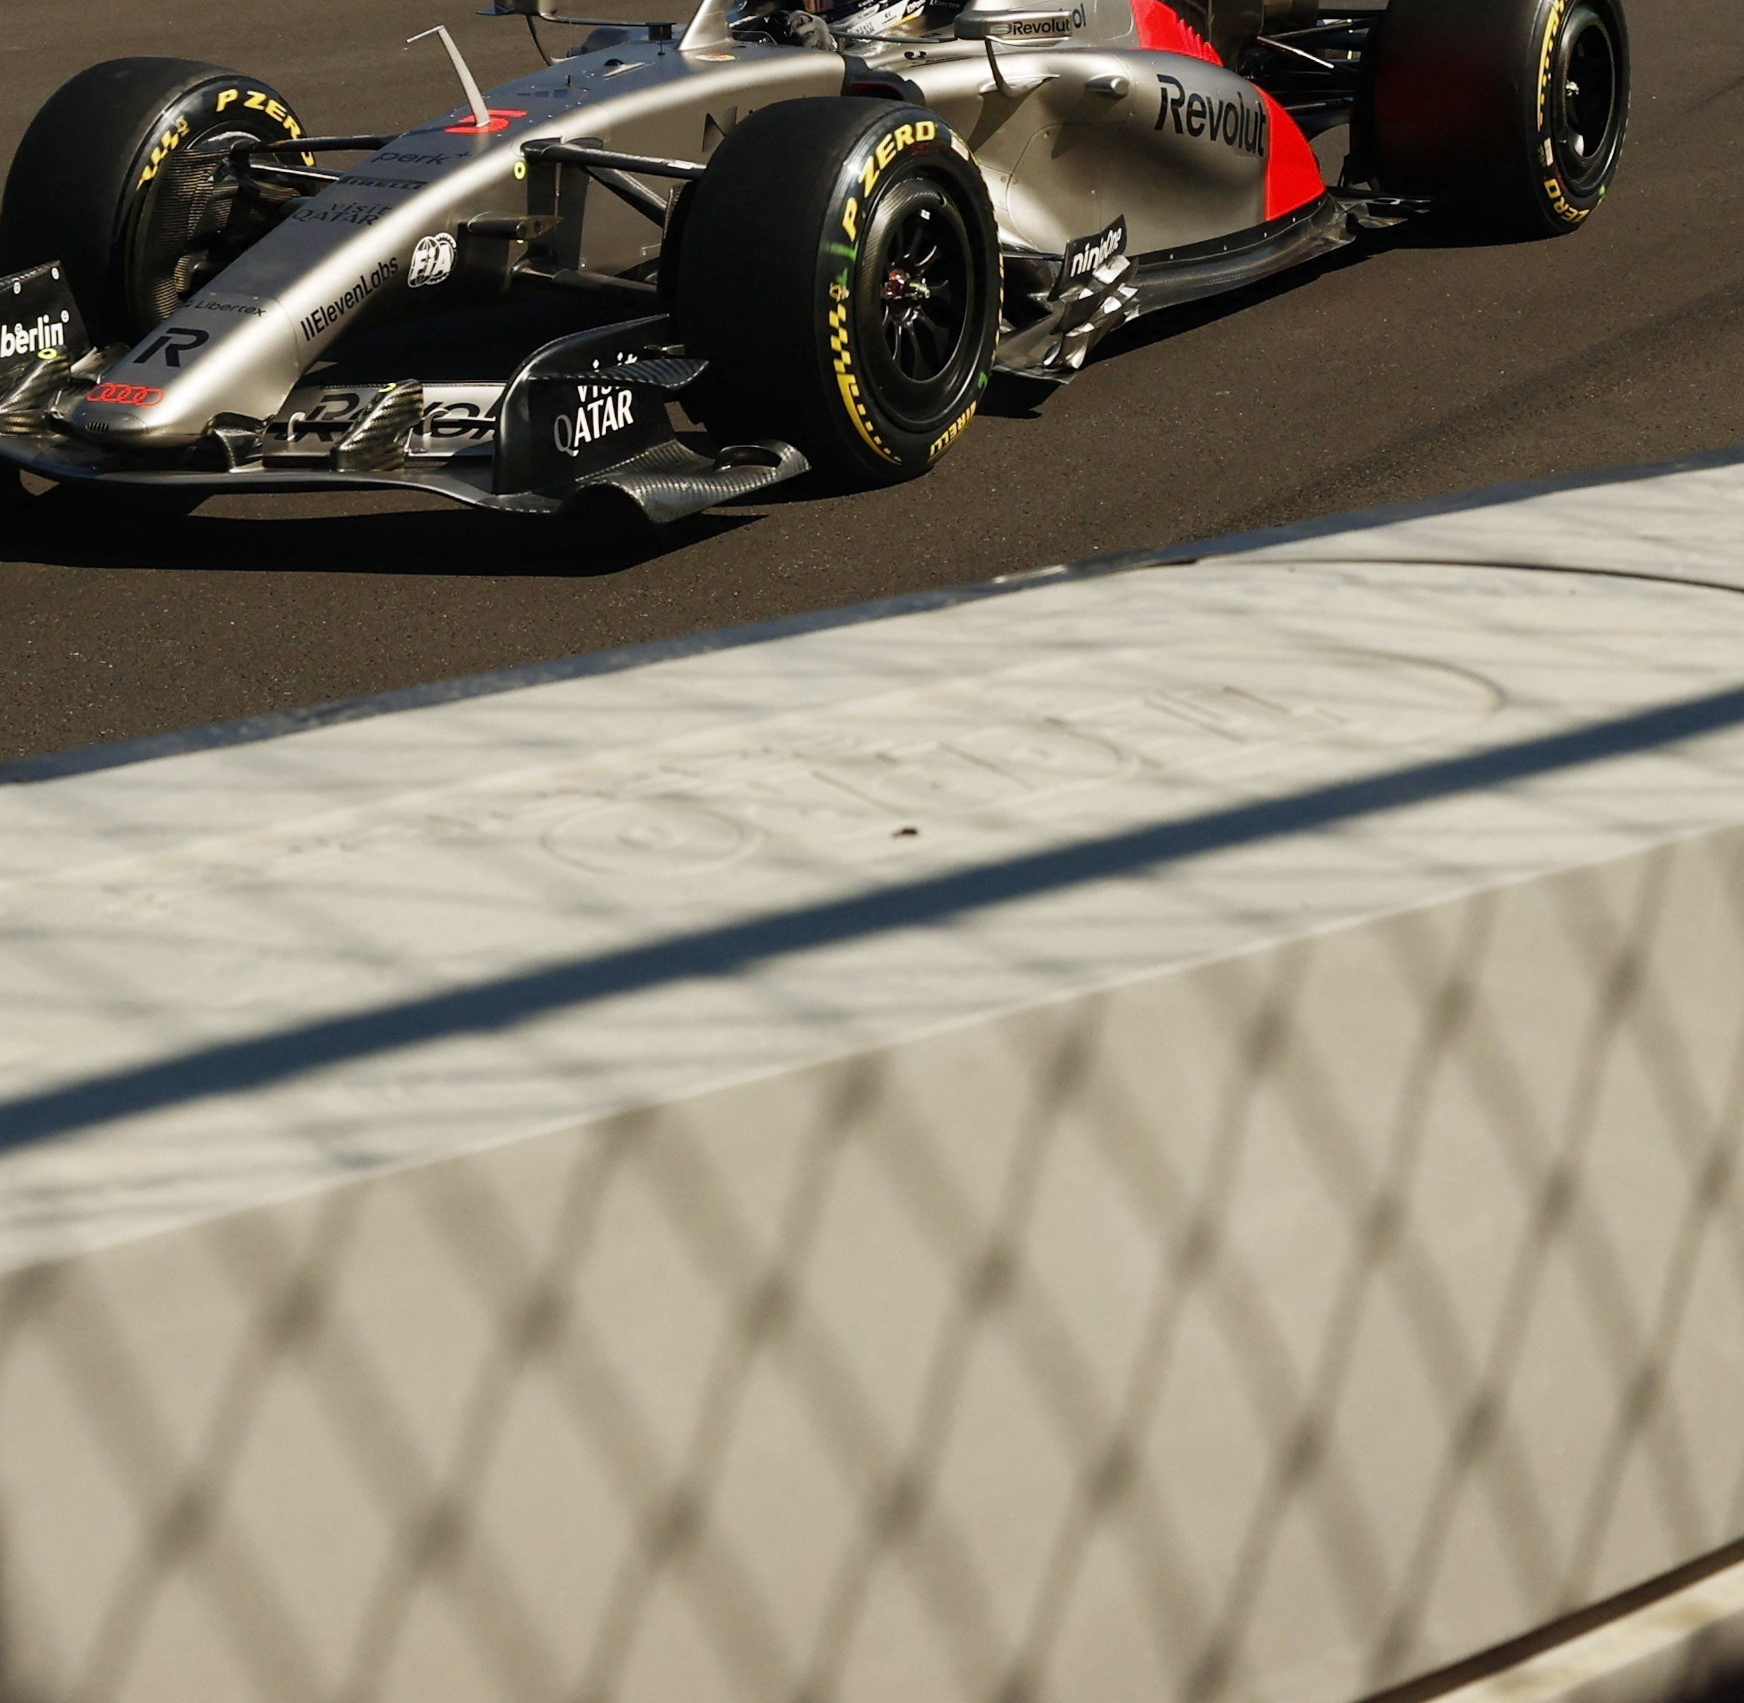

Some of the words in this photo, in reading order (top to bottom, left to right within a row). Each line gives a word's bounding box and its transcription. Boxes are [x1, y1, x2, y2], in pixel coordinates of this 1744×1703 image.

[1012, 17, 1071, 36] Revolut
[215, 88, 239, 113] P
[1155, 73, 1267, 158] Revolut
[842, 196, 858, 242] P
[857, 120, 936, 198] ZERO
[1543, 178, 1591, 224] ZERO
[330, 202, 393, 216] visit
[196, 300, 268, 318] Libertex
[0, 314, 66, 359] berlin
[133, 327, 210, 368] R
[553, 389, 634, 458] QATAR
